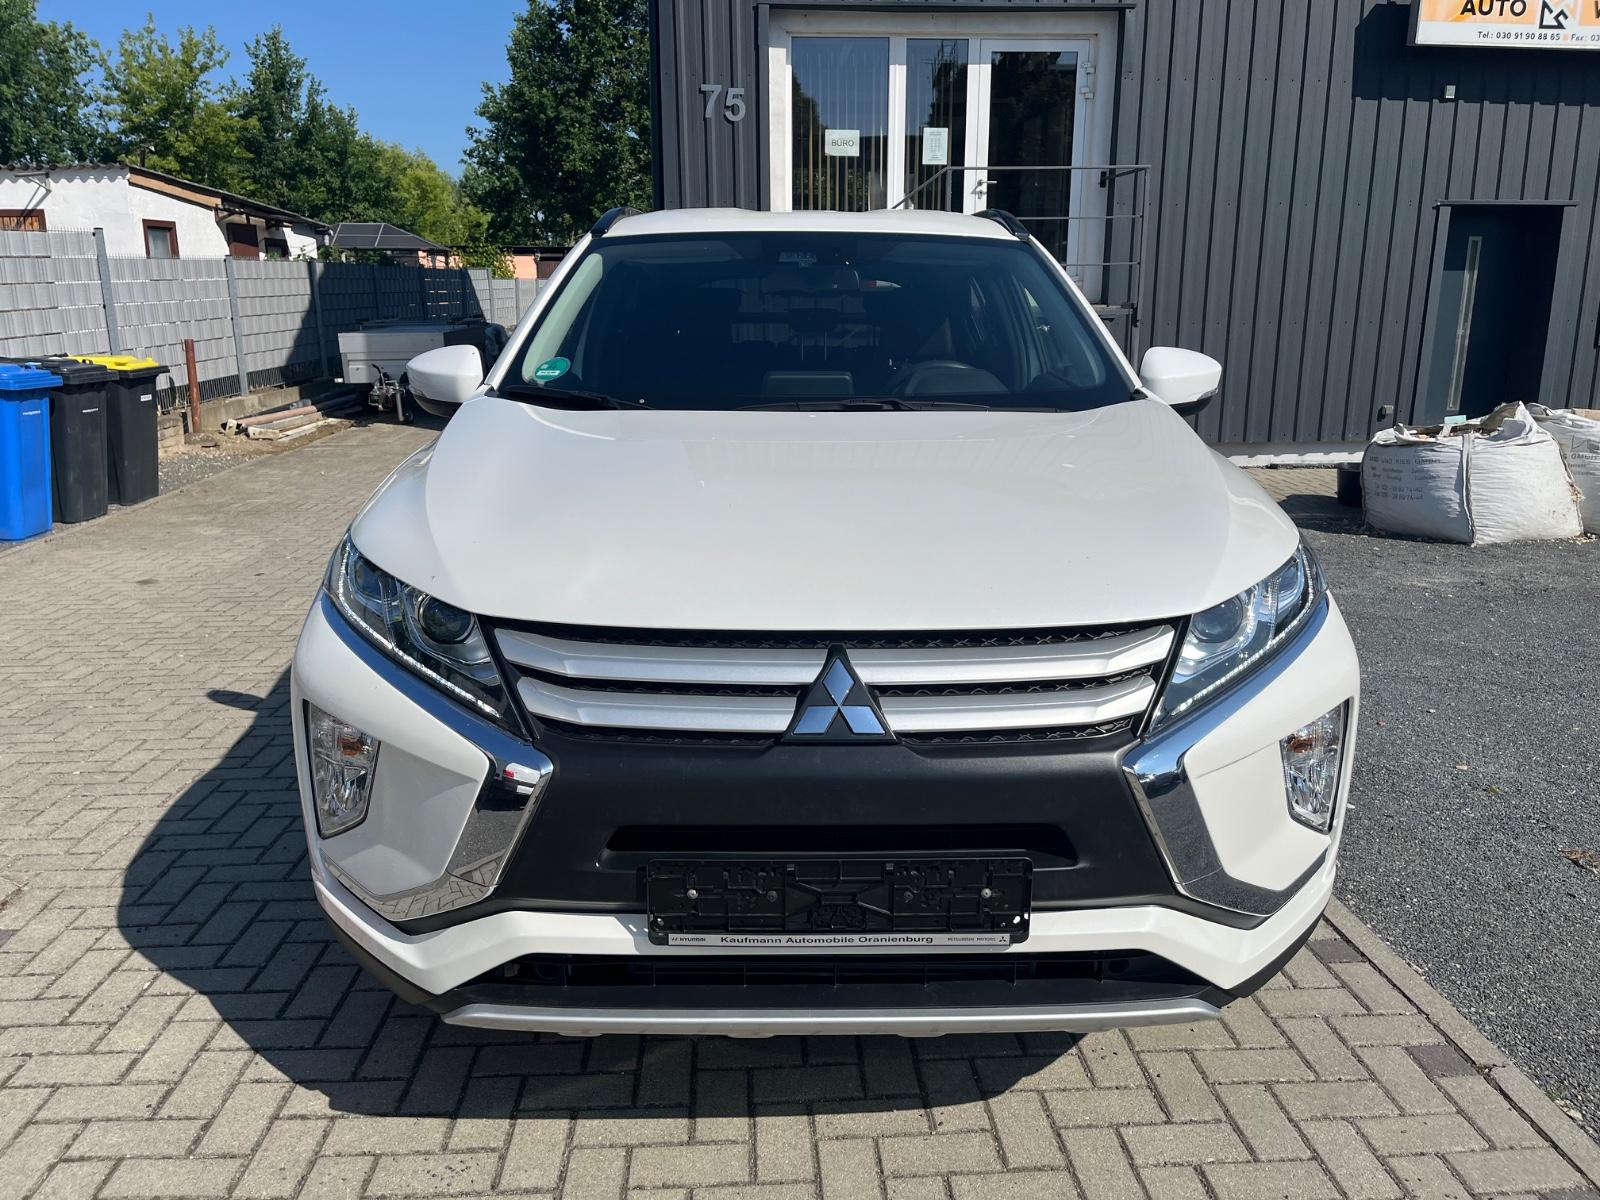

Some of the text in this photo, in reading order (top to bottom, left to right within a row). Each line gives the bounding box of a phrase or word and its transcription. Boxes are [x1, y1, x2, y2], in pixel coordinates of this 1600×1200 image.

[1460, 0, 1527, 16] AUTO
[1496, 31, 1512, 40] 030
[1513, 32, 1523, 40] 91
[1525, 32, 1536, 40] 90
[1537, 33, 1548, 41] 88
[1550, 33, 1561, 41] 65
[700, 84, 747, 122] 75
[831, 137, 855, 148] BÜRO
[720, 936, 782, 944] Kaufmann
[786, 936, 855, 944] Automobile
[858, 936, 934, 944] Oranienburg
